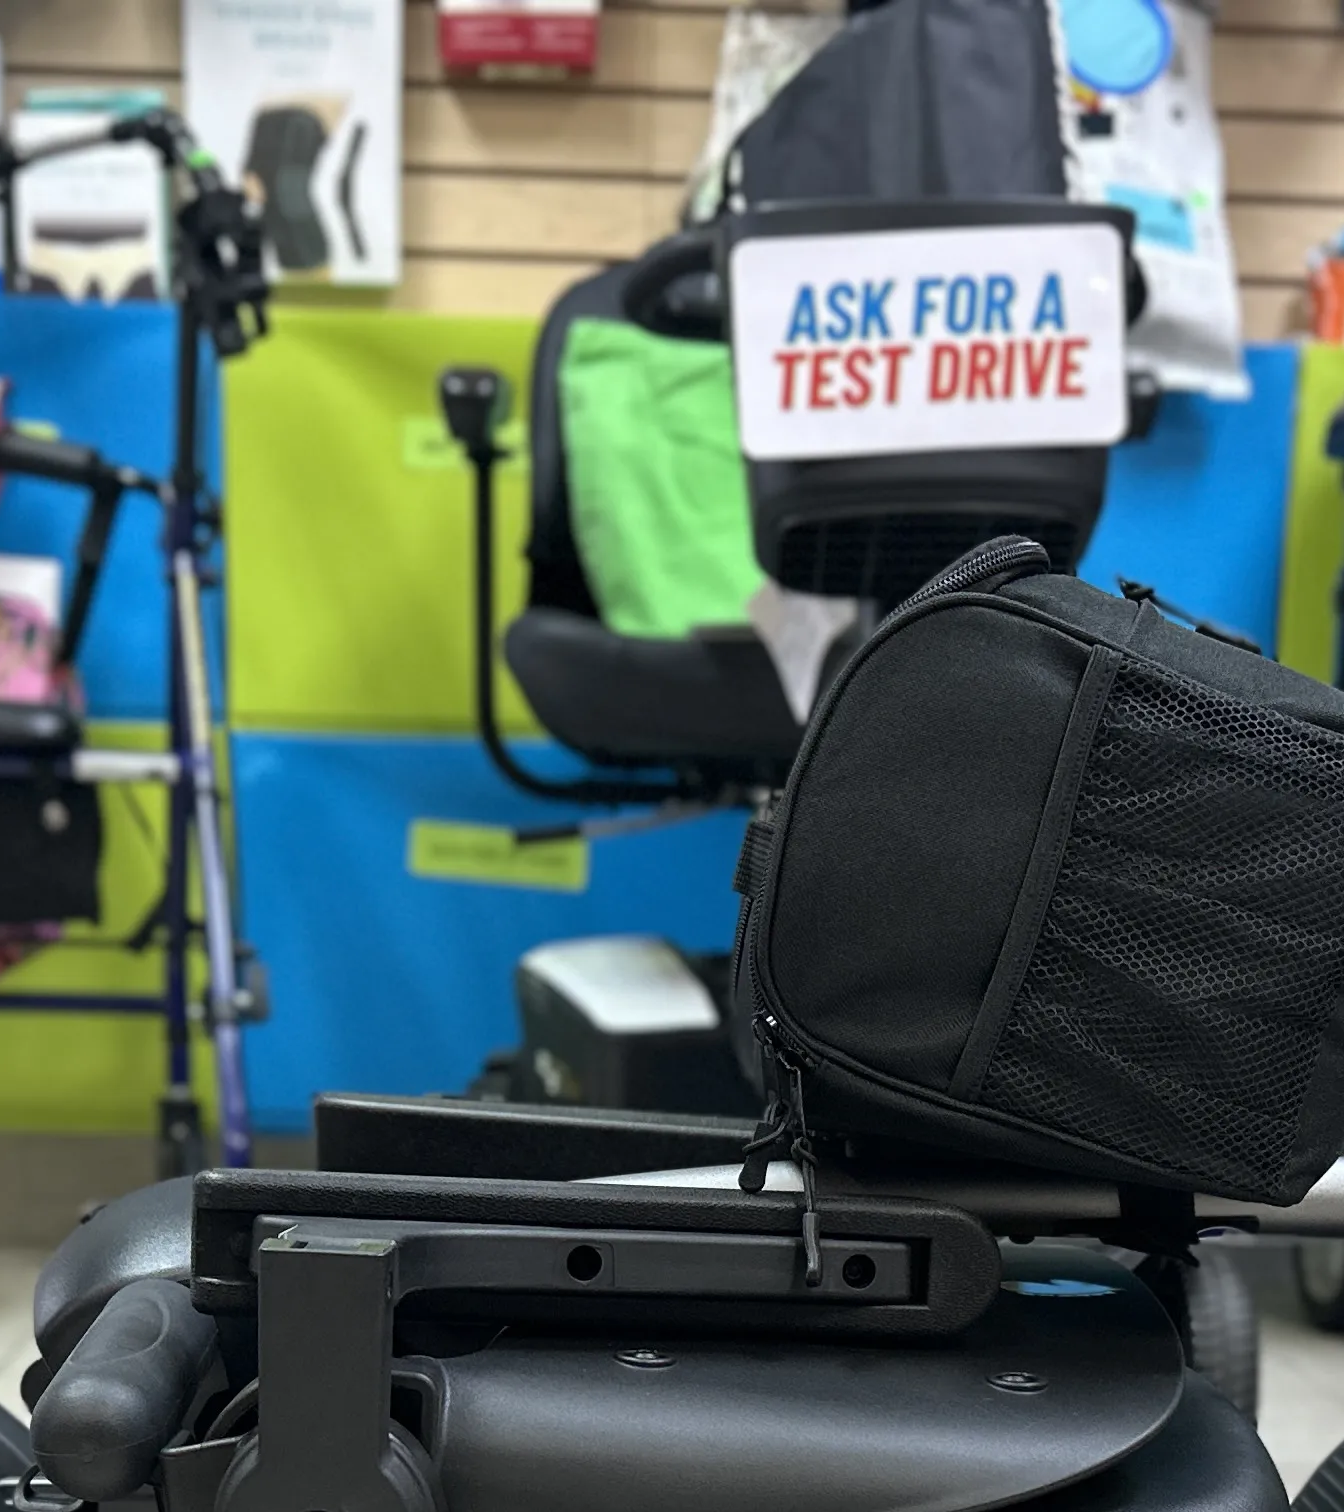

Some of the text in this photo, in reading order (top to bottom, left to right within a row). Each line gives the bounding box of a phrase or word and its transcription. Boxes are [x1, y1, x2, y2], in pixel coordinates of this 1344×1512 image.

[784, 271, 1066, 343] ASK FOR A
[773, 337, 1090, 412] TEST DRIVE
